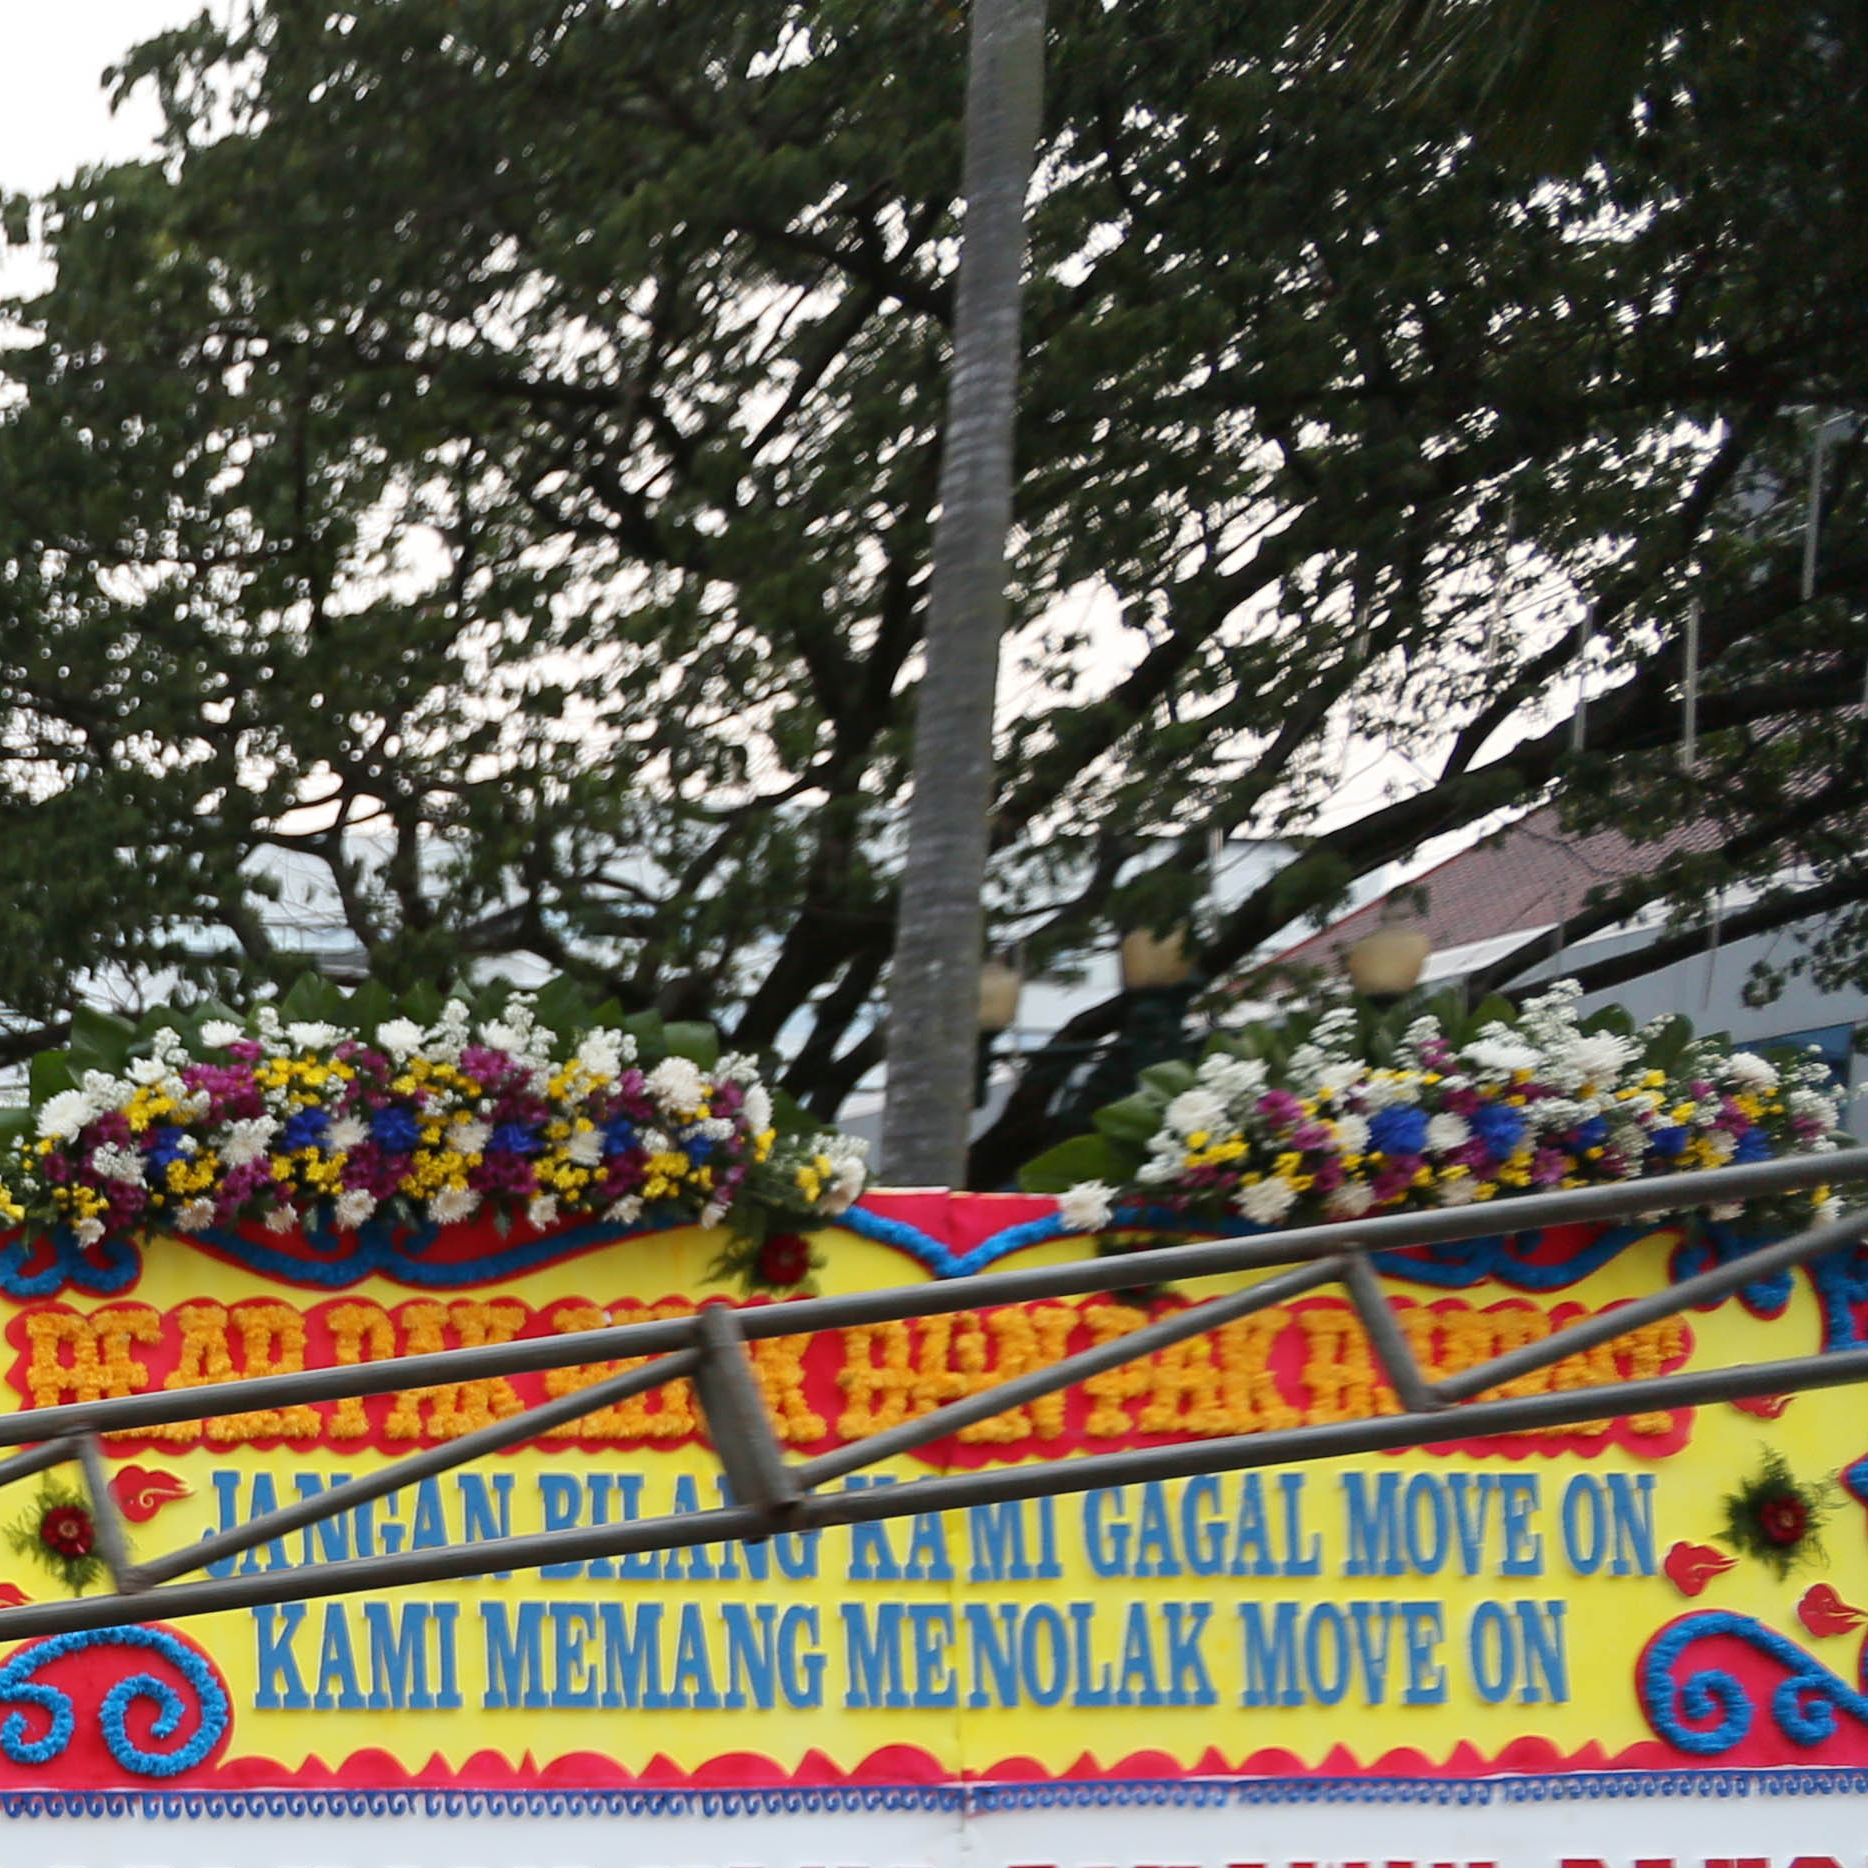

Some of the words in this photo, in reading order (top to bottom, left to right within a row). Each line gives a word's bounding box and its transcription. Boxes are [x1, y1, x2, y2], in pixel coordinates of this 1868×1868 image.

[541, 1307, 828, 1442] AHK
[203, 1471, 511, 1580] JANGAN
[845, 1475, 1062, 1582] KAMI
[1082, 1473, 1321, 1580] GAGAL
[1339, 1472, 1543, 1577] MOVE
[1561, 1472, 1659, 1577] ON
[252, 1602, 460, 1709] KAMI
[482, 1601, 828, 1709] MEMANG
[841, 1600, 1219, 1708] MENOLAK
[1241, 1601, 1449, 1704] MOVE
[1469, 1600, 1569, 1703] ON
